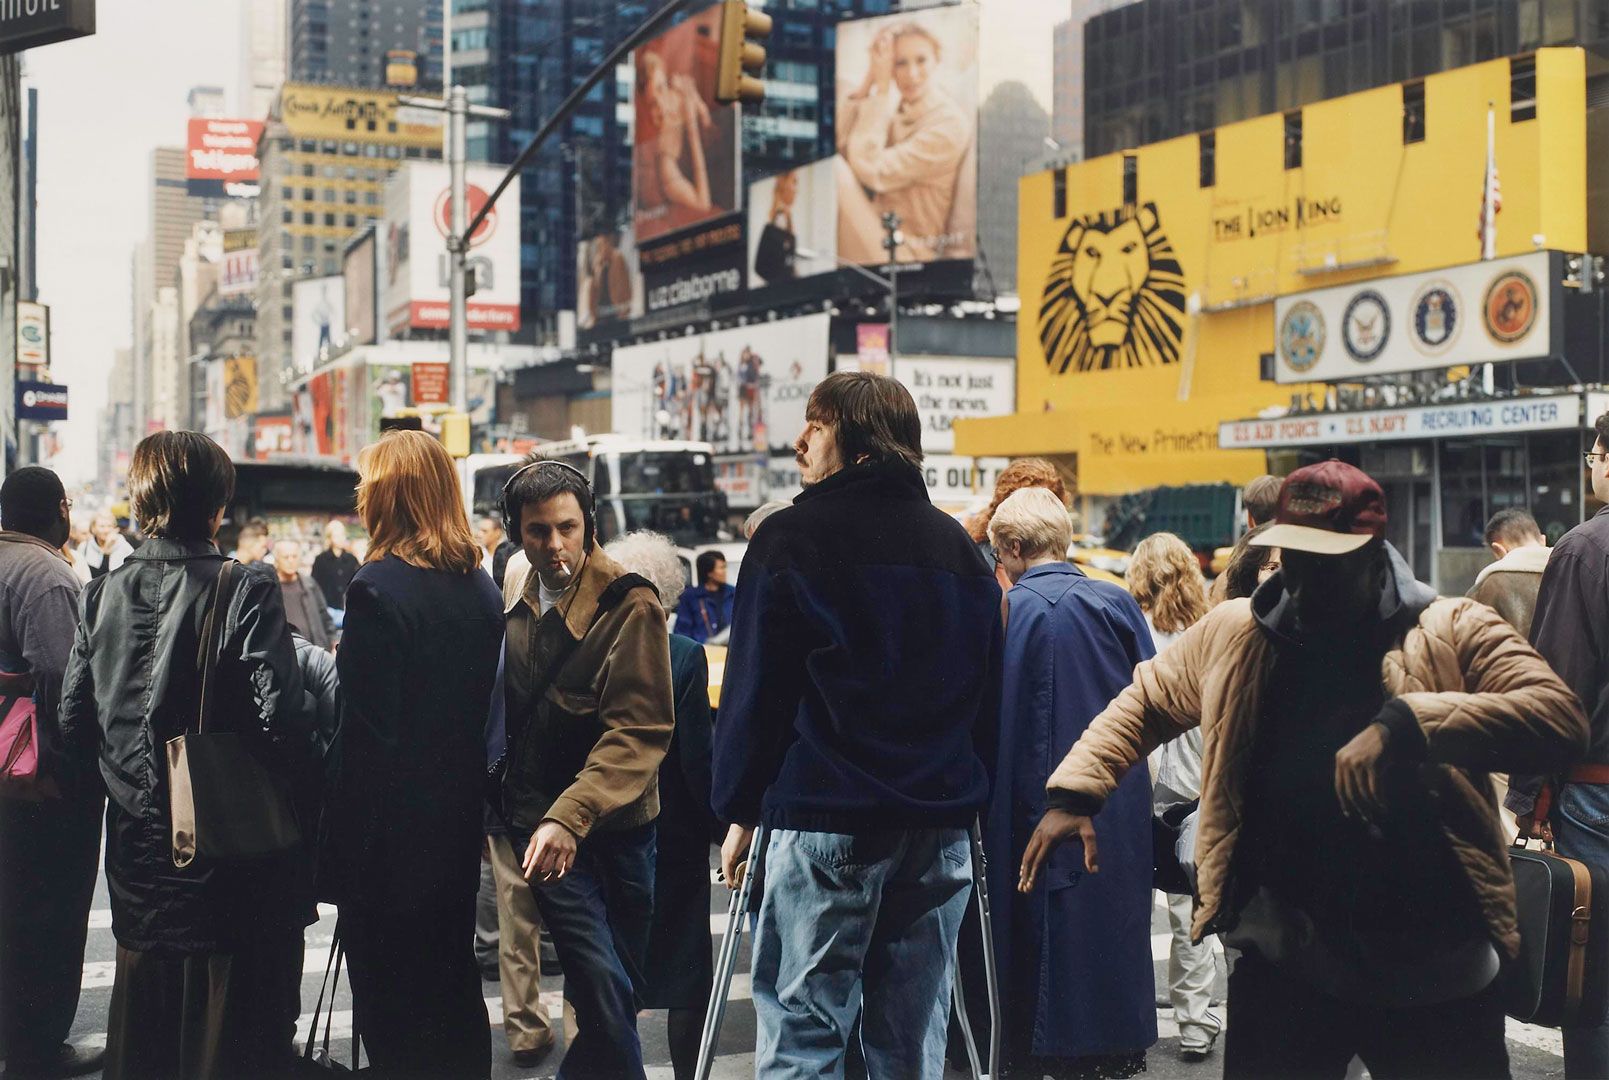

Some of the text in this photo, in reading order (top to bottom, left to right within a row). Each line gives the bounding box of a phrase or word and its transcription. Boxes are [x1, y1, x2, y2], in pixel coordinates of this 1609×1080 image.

[1214, 196, 1342, 239] THE LION KING
[914, 368, 994, 392] It's not just
[919, 393, 942, 410] the
[1280, 419, 1320, 439] FORCE
[1370, 412, 1408, 432] NAVY
[1502, 403, 1559, 425] CENTER
[1090, 433, 1114, 455] The
[1120, 431, 1148, 453] New
[947, 468, 987, 488] OUT
